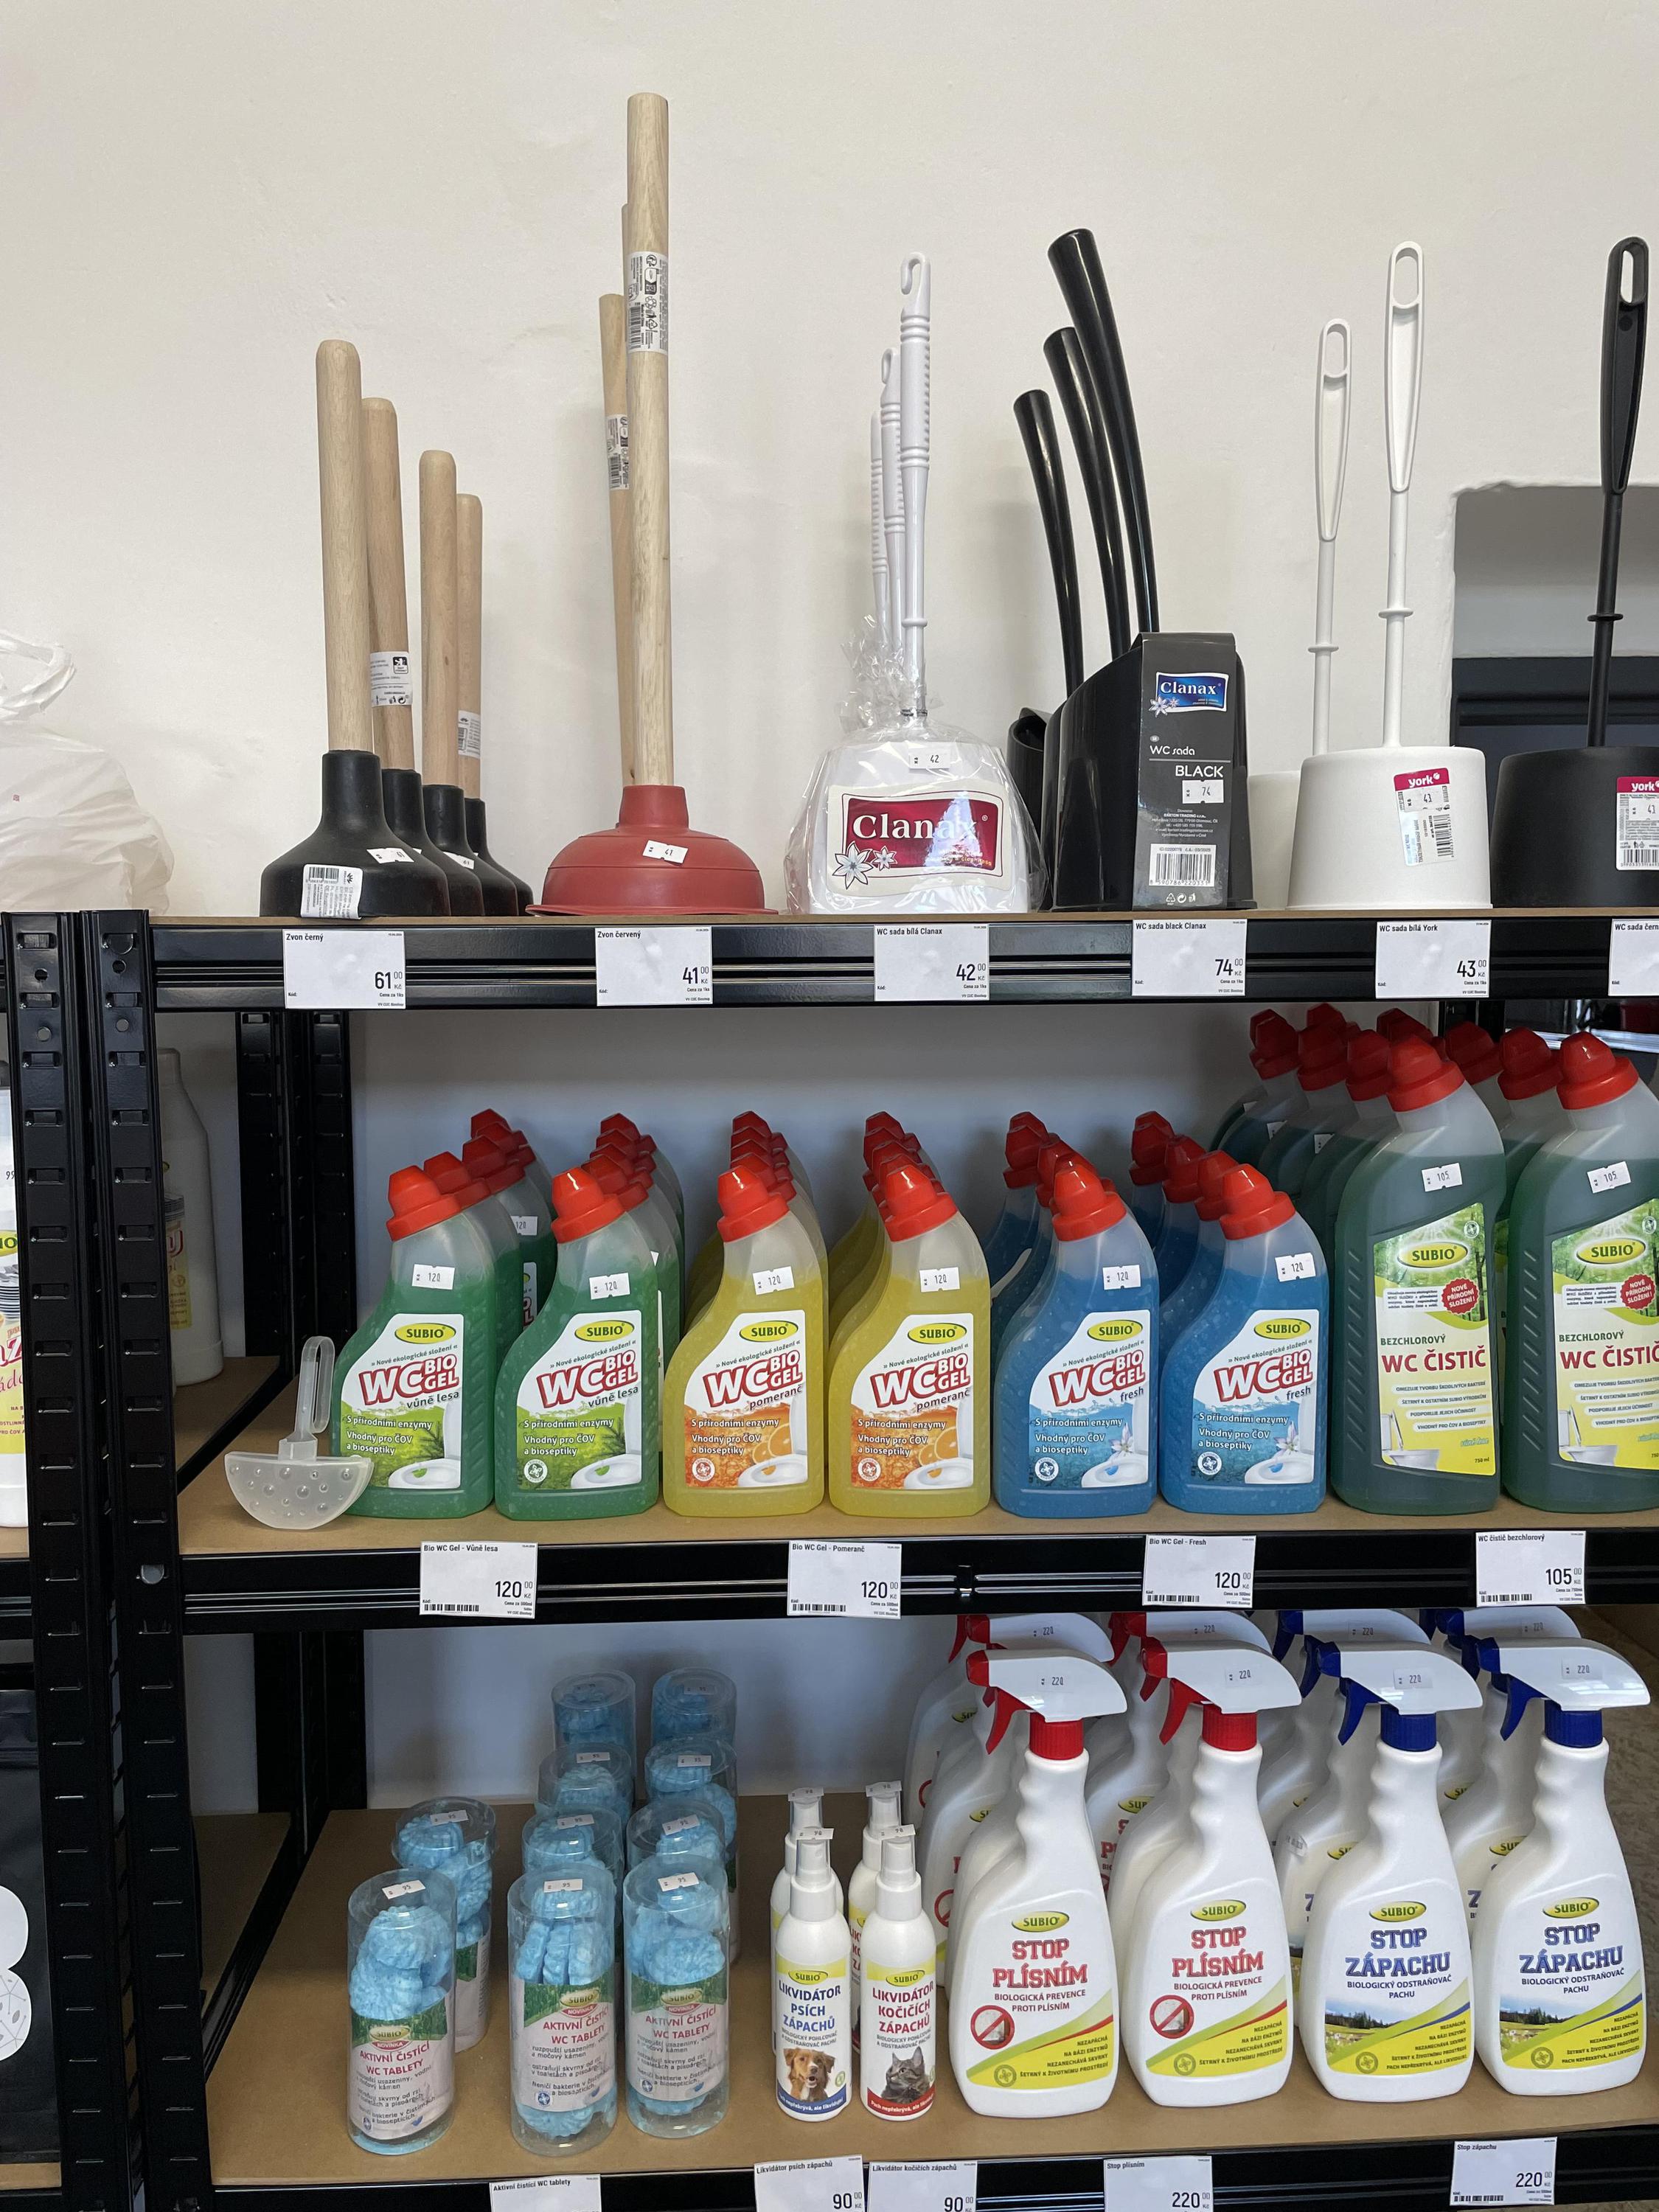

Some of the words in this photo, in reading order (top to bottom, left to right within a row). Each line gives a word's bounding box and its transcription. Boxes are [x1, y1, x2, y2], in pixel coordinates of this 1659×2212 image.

[1161, 681, 1216, 695] Clanax
[1150, 745, 1170, 755] WC
[1172, 745, 1196, 756] sada
[930, 754, 939, 763] 42
[1175, 765, 1224, 778] BLACK
[1408, 774, 1434, 788] york
[1631, 782, 1655, 793] york
[1201, 787, 1211, 796] 74
[1423, 793, 1433, 803] 43
[852, 813, 978, 839] Clanax
[615, 931, 641, 940] červený
[906, 927, 919, 935] bílá
[1408, 924, 1422, 932] bílá
[305, 933, 324, 942] černý
[956, 964, 976, 981] 42
[1215, 959, 1234, 976] 74
[1456, 960, 1476, 978] 43
[375, 972, 392, 990] 61
[682, 967, 698, 984] 41
[1436, 1171, 1450, 1182] 105
[1411, 1248, 1455, 1262] SUBIO
[1591, 1244, 1633, 1258] SUBIO
[427, 1272, 441, 1282] 120
[1446, 1289, 1475, 1303] PŘÍRODNÍ
[1450, 1284, 1468, 1293] NOVÉ
[406, 1327, 444, 1339] SUBIO
[586, 1325, 623, 1336] SUBIO
[751, 1325, 787, 1338] SUBIO
[919, 1327, 956, 1340] SUBIO
[1099, 1324, 1133, 1336] SUBIO
[1265, 1322, 1301, 1334] SUBIO
[1380, 1334, 1446, 1346] BEZCHLOROVÝ
[376, 1358, 392, 1366] Nové
[392, 1352, 428, 1364] ekologické
[428, 1347, 452, 1358] složení
[1381, 1354, 1419, 1374] WC
[1423, 1346, 1486, 1373] ČISTIČ
[358, 1363, 425, 1405] WC
[424, 1354, 457, 1374] BIO
[423, 1369, 459, 1391] GEL
[536, 1359, 605, 1408] WC
[605, 1349, 636, 1371] BIO
[603, 1363, 638, 1388] GEL
[703, 1360, 771, 1408] WC
[770, 1350, 801, 1373] BIO
[769, 1365, 803, 1391] GEL
[869, 1362, 939, 1409] WC
[938, 1352, 969, 1376] BIO
[936, 1368, 971, 1394] GEL
[1048, 1359, 1116, 1407] WC
[1115, 1349, 1144, 1373] BIO
[1115, 1364, 1146, 1391] GEL
[1214, 1356, 1283, 1402] WC
[1281, 1349, 1312, 1371] BIO
[1281, 1364, 1313, 1388] GEL
[406, 1394, 434, 1409] vůně
[436, 1391, 459, 1402] lesa
[749, 1384, 803, 1411] pomeranč
[1119, 1387, 1145, 1403] fresh
[347, 1416, 352, 1424] S
[352, 1416, 396, 1429] přírodními
[397, 1419, 432, 1430] enzymy
[347, 1430, 377, 1442] Vhodný
[378, 1435, 392, 1444] pro
[394, 1431, 413, 1443] ČOV
[352, 1443, 395, 1456] bioseptiky
[1507, 1534, 1545, 1542] bezchlorový
[466, 1544, 483, 1552] Vůně
[832, 1545, 865, 1553] Pomeranč
[1214, 1572, 1241, 1589] 120
[1545, 1568, 1572, 1585] 105
[495, 1581, 522, 1599] 120
[861, 1581, 888, 1599] 120
[1051, 1676, 1064, 1686] 220
[1239, 1669, 1251, 1680] 220
[1202, 1905, 1236, 1916] SUBIO
[1380, 1906, 1416, 1917] SUBIO
[1554, 1902, 1589, 1914] SUBIO
[1023, 1916, 1058, 1927] SUBIO
[1191, 1925, 1248, 1950] STOP
[1370, 1927, 1428, 1950] STOP
[1544, 1922, 1601, 1947] STOP
[1012, 1938, 1069, 1960] STOP
[1172, 1947, 1265, 1978] PLÍSNÍM
[1344, 1950, 1451, 1978] ZÁPACHU
[1518, 1945, 1624, 1975] ZÁPACHU
[992, 1960, 1088, 1989] PLÍSNÍM
[1346, 1978, 1395, 1989] BIOLOGICKÝ
[1397, 1973, 1453, 1989] ODSTRAŇOVAČ
[778, 1980, 841, 2002] LIKVIDÁTOR
[872, 1980, 935, 2004] LIKVIDÁTOR
[994, 1990, 1044, 2001] BIOLOGICKÁ
[1046, 1989, 1086, 2000] PREVENCE
[1388, 1990, 1415, 2000] PACHU
[790, 2003, 826, 2017] PSÍCH
[878, 1998, 931, 2019] KOČIČÍCH
[1011, 2003, 1037, 2012] PROTI
[1037, 2000, 1070, 2011] PLÍSNÍM
[543, 2017, 583, 2031] AKTIVNÍ
[782, 2014, 836, 2033] ZÁPACHŮ
[879, 2014, 931, 2035] ZÁPACHŮ
[551, 2034, 568, 2045] WC
[571, 2023, 605, 2044] TABLETY
[756, 2163, 788, 2175] Likvidátor
[788, 2162, 806, 2171] psích
[807, 2160, 833, 2171] zápachů
[872, 2163, 903, 2172] Likvidátor
[904, 2163, 930, 2173] kočičích
[931, 2163, 958, 2173] zápachů
[493, 2183, 516, 2192] Aktivní
[549, 2178, 571, 2187] tablety
[1515, 2171, 1543, 2188] 220
[832, 2193, 852, 2210] 90
[944, 2197, 964, 2212] 90
[1172, 2191, 1200, 2208] 220
